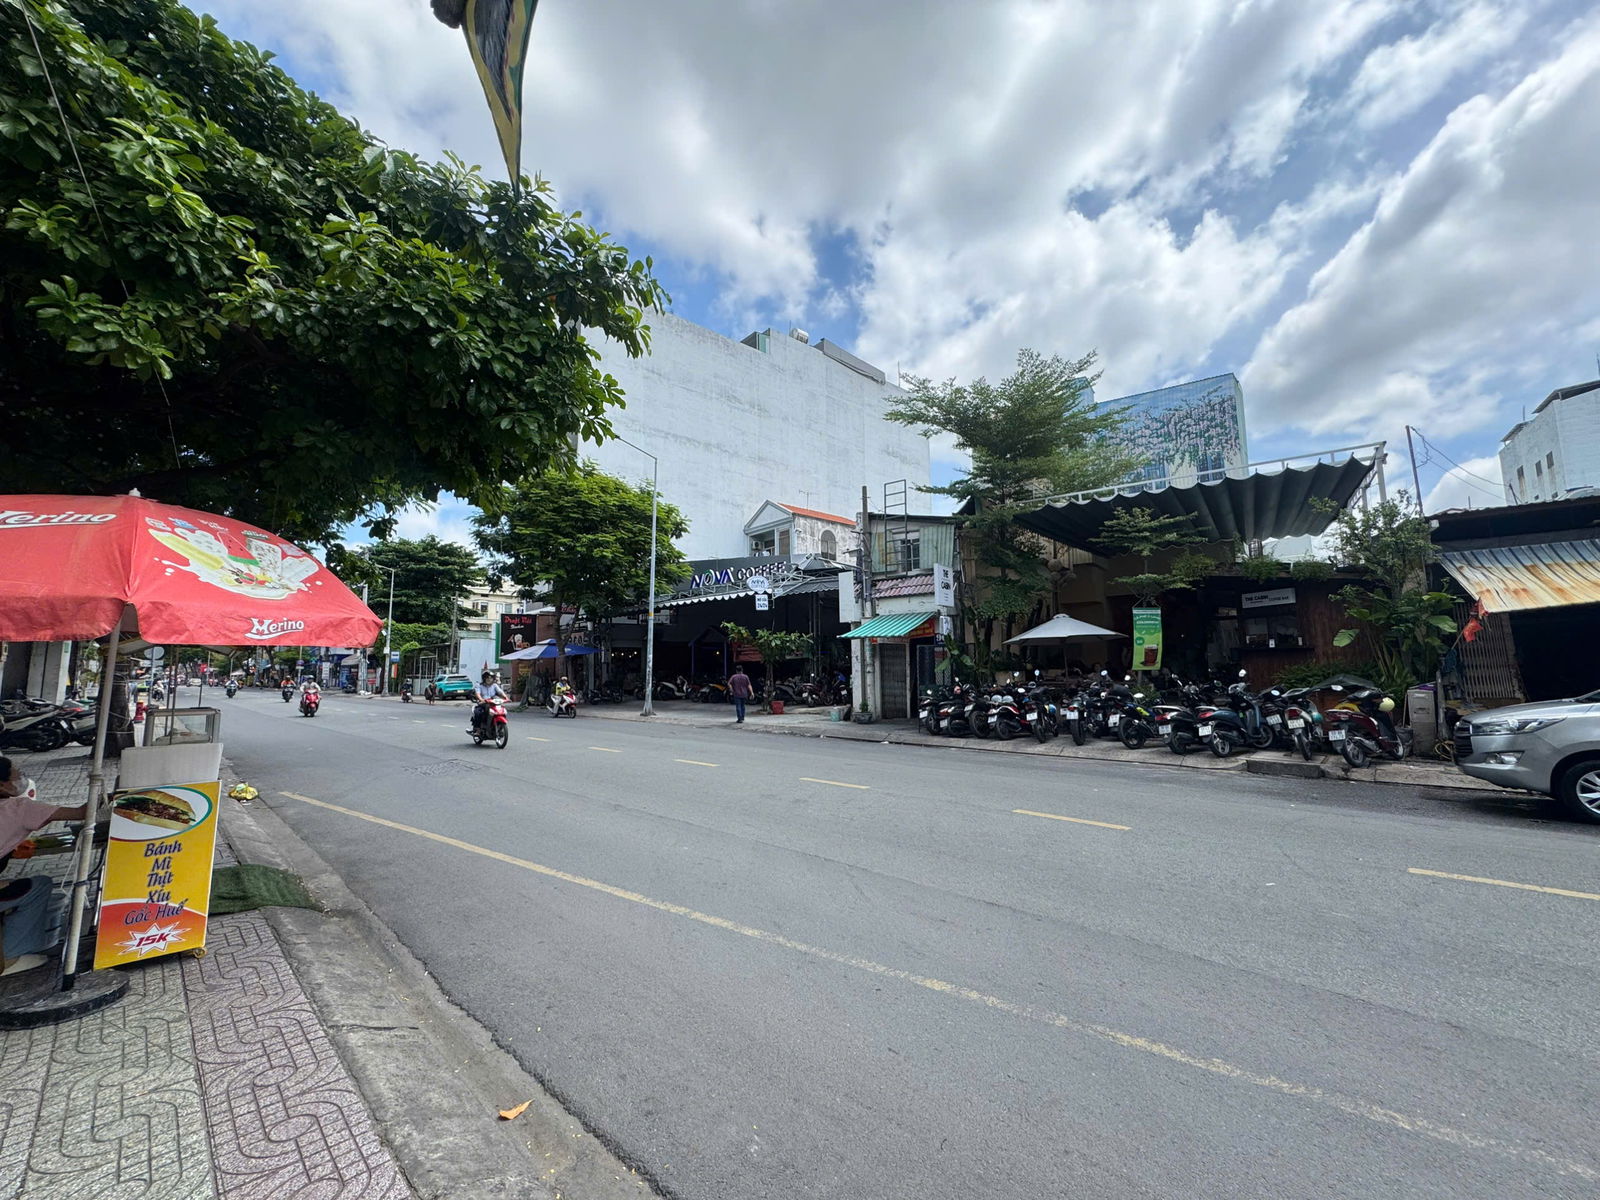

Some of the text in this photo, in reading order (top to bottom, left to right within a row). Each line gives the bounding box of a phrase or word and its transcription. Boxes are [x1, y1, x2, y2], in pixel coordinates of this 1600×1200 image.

[691, 561, 786, 589] NOVA COFFEE
[248, 617, 305, 637] Merino
[144, 840, 182, 857] Bánh
[147, 871, 174, 888] Thịt
[145, 888, 172, 904] Xíu
[155, 899, 188, 920] Huế
